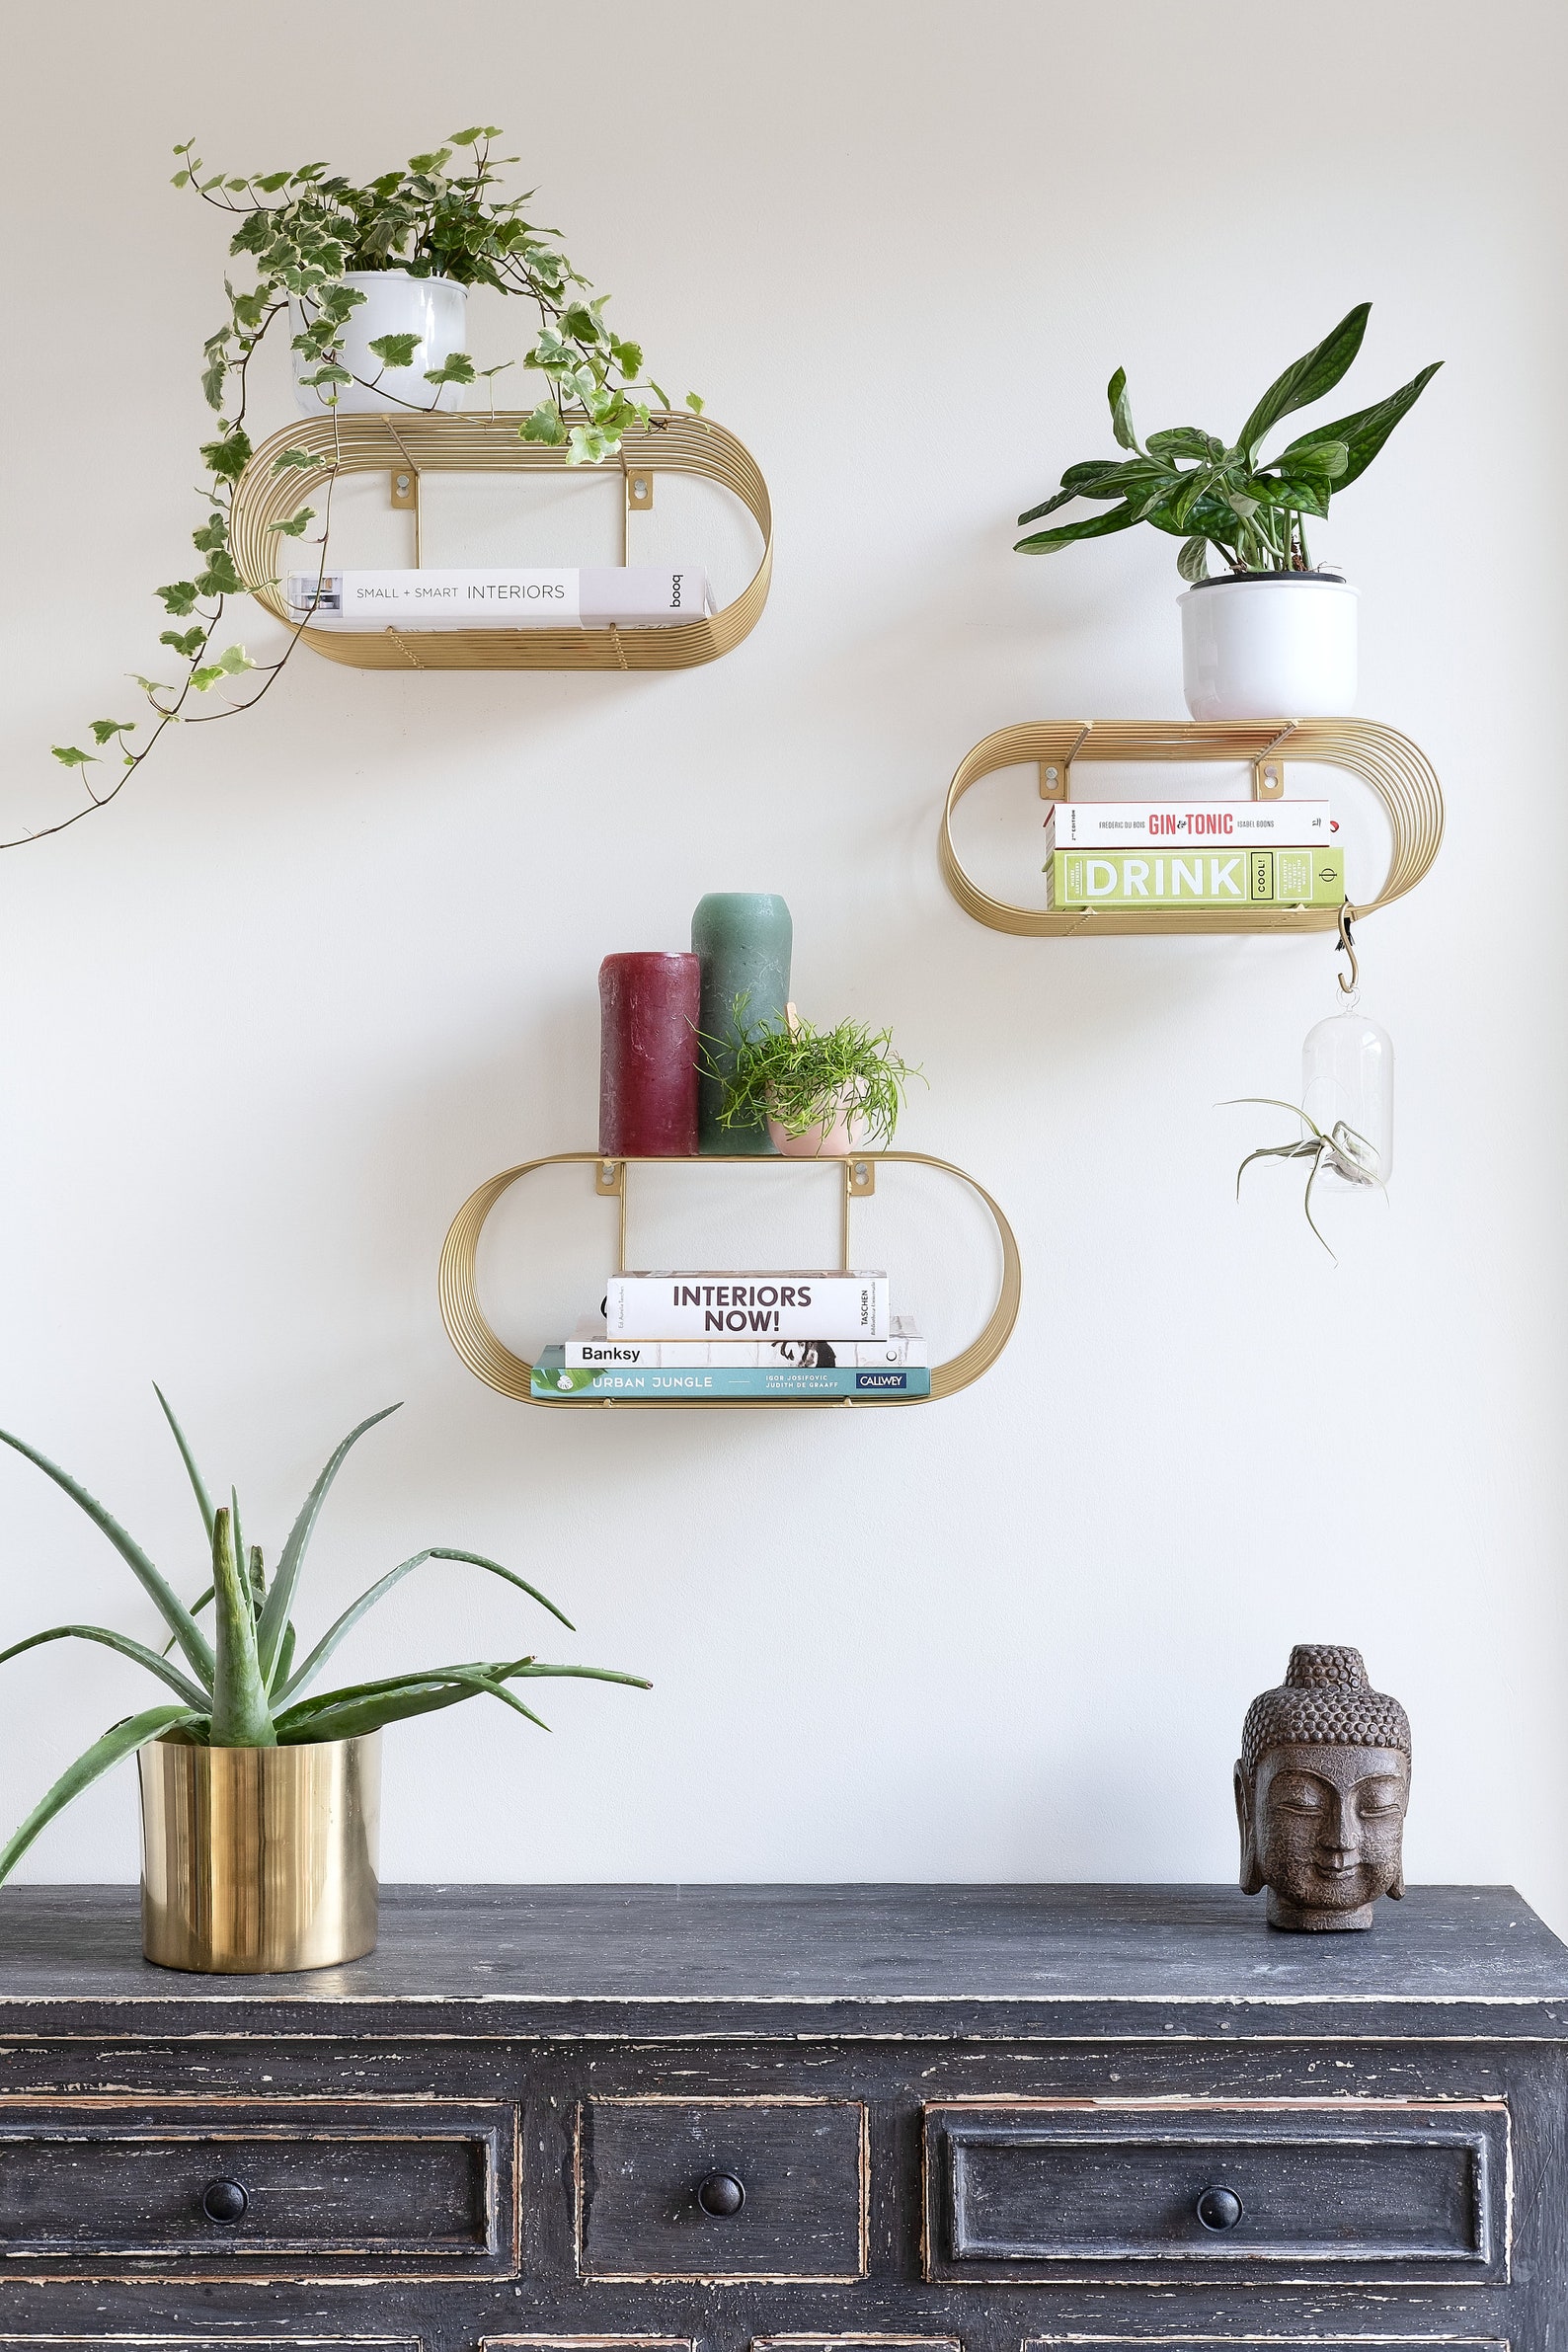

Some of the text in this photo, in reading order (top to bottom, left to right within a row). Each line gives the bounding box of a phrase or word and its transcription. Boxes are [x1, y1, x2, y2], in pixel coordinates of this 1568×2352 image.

[356, 588, 399, 598] SMALL
[415, 587, 459, 598] SMART
[467, 585, 566, 599] INTERIORS
[668, 574, 684, 608] booq
[1148, 814, 1176, 835] GIN
[1185, 813, 1233, 835] TONIC
[1256, 820, 1275, 828] BOONS
[1086, 859, 1242, 897] DRINK
[1257, 860, 1266, 893] COOL!
[673, 1286, 812, 1307] INTERIORS
[705, 1310, 780, 1332] NOW!
[582, 1347, 641, 1363] Banksy
[592, 1376, 713, 1388] URBAN JUNGLE
[859, 1375, 903, 1386] CALLWEY
